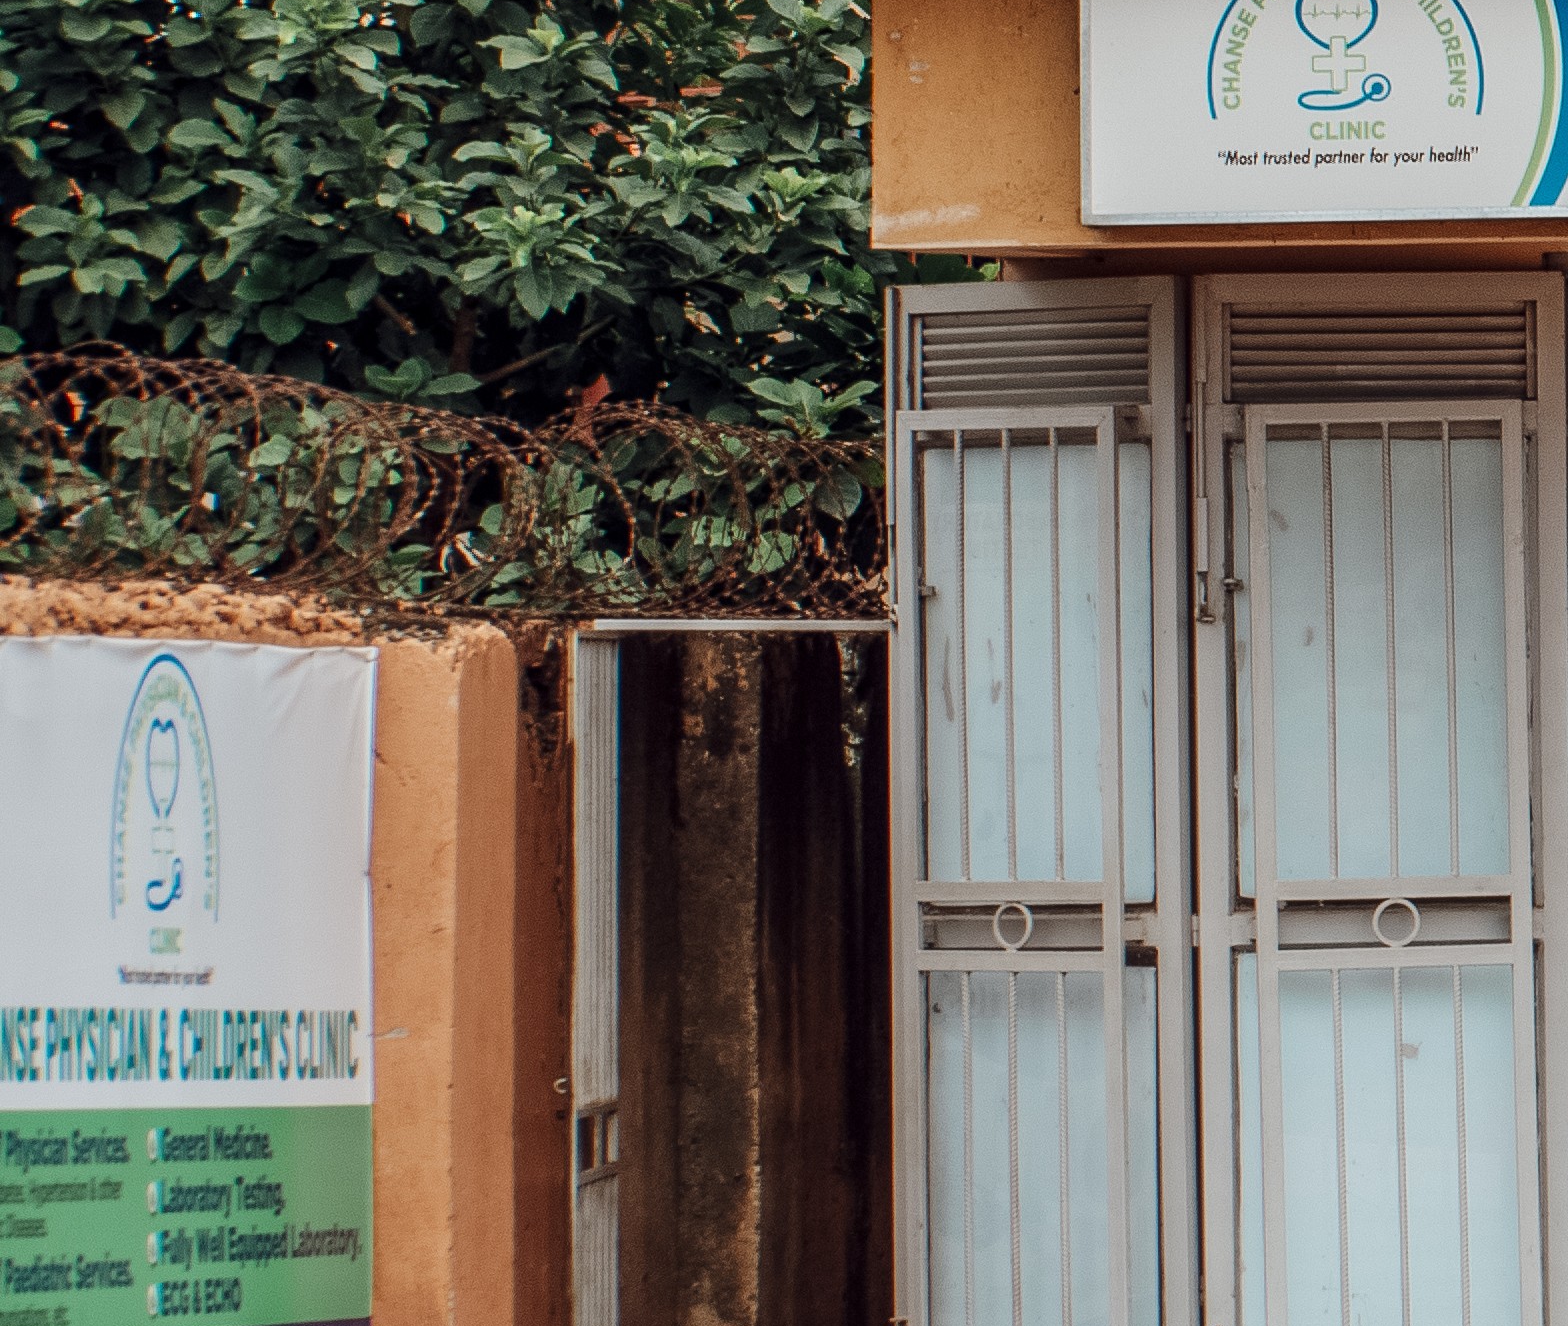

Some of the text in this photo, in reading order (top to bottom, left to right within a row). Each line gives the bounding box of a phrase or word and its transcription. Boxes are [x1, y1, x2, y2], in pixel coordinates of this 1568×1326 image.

[1221, 8, 1257, 111] CHANSE
[1309, 120, 1386, 141] CLINIC
[1263, 147, 1311, 166] trusted
[1314, 149, 1365, 168] partner
[1370, 147, 1390, 164] for
[1393, 150, 1425, 167] your
[46, 1007, 151, 1081] PHYSICIAN
[296, 1009, 360, 1080] CLINIC
